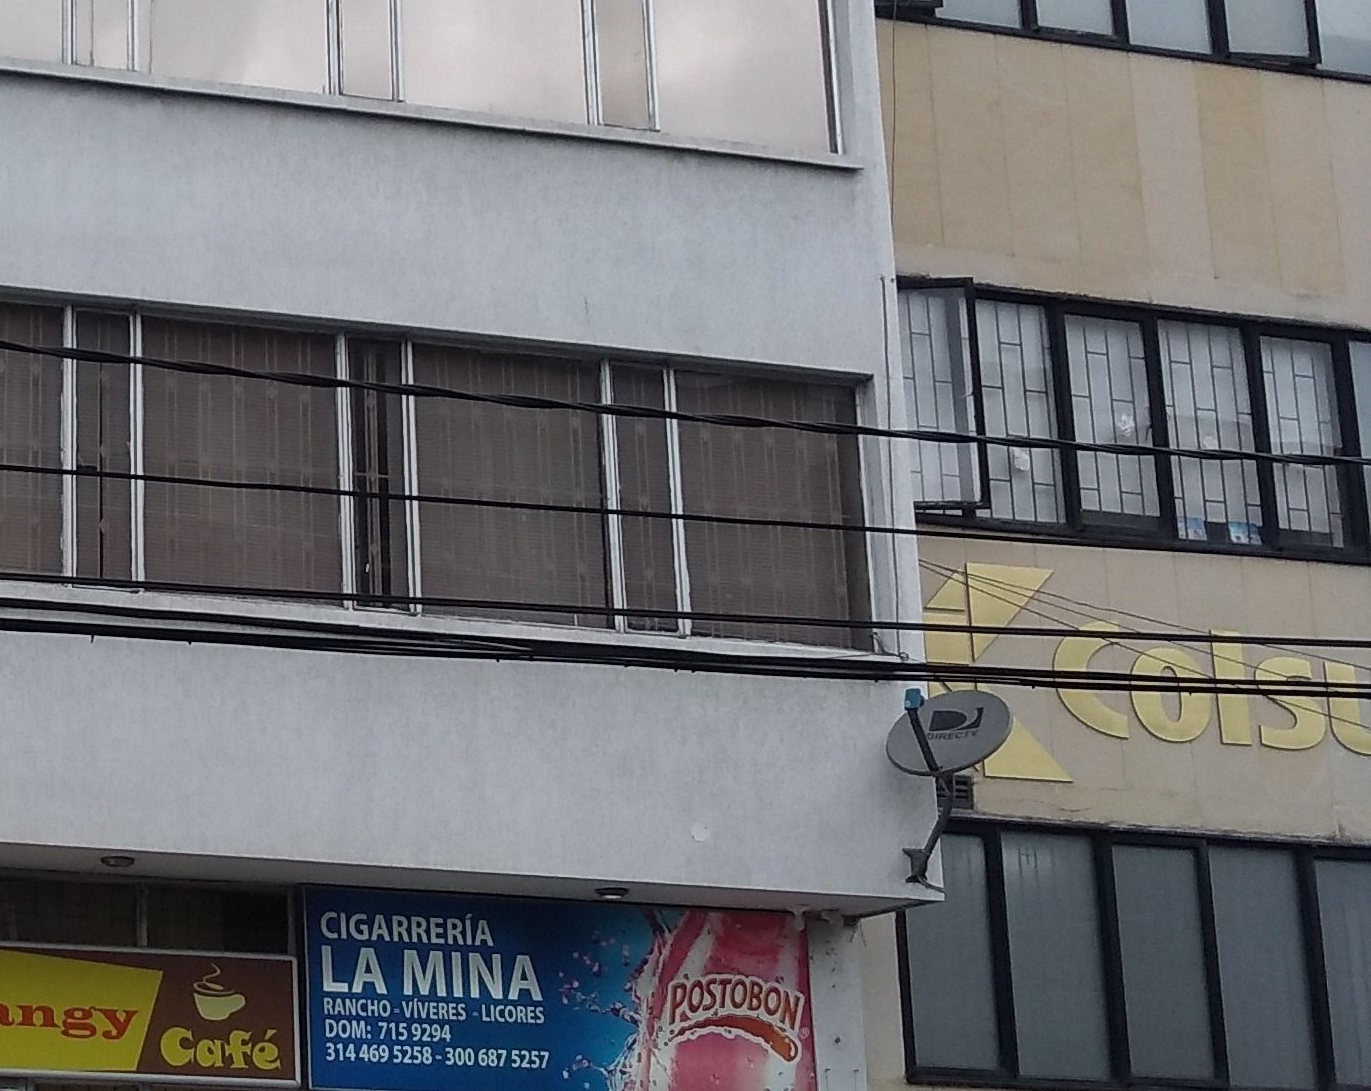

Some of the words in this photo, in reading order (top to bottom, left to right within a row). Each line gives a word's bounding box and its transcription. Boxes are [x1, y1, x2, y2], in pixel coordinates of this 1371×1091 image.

[926, 730, 979, 740] DIRECTV
[320, 911, 495, 947] CIGARRERÍA
[321, 944, 388, 995] LA
[402, 949, 544, 1002] MINA
[323, 997, 392, 1017] RANCHO
[481, 1004, 545, 1023] LICORES
[325, 1019, 372, 1039] DOM:
[378, 1021, 408, 1041] 715
[411, 1023, 452, 1042] 9294
[159, 1027, 282, 1071] Café
[325, 1042, 357, 1061] 314
[359, 1044, 389, 1063] 469
[392, 1045, 433, 1064] 5258
[445, 1047, 475, 1066] 300
[478, 1049, 507, 1068] 687
[511, 1051, 550, 1069] 5257
